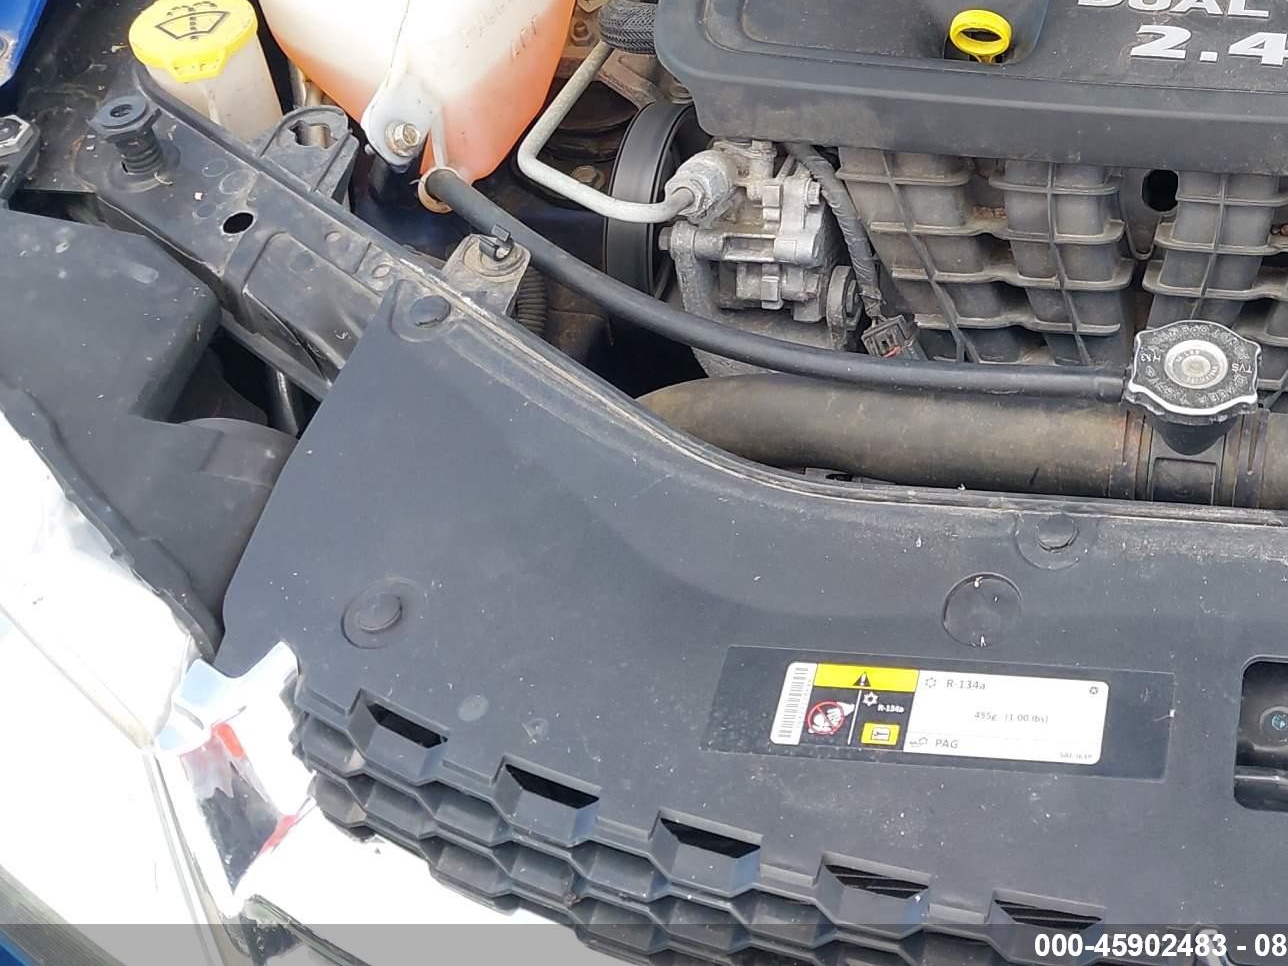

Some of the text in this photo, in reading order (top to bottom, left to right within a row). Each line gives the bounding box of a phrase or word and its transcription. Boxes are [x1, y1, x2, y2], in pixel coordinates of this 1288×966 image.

[1231, 362, 1253, 375] TVS
[946, 678, 986, 691] R-134a
[935, 738, 959, 750] PAG
